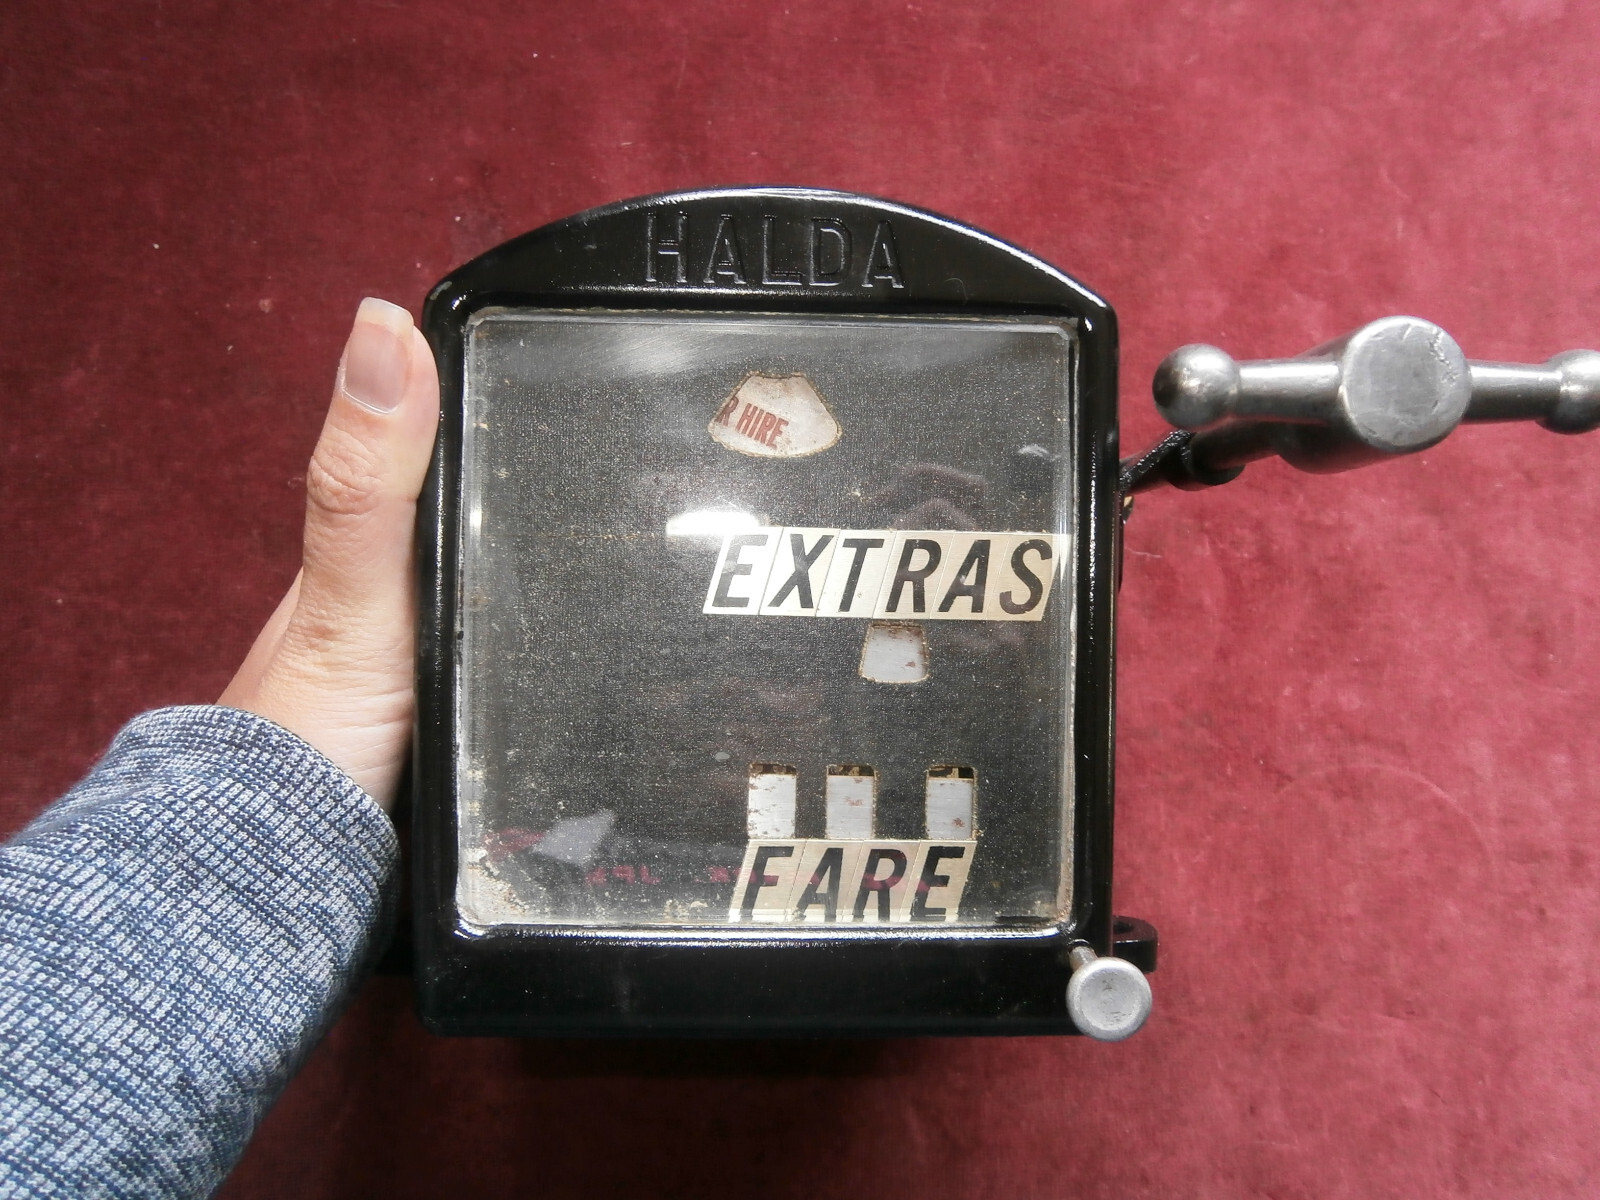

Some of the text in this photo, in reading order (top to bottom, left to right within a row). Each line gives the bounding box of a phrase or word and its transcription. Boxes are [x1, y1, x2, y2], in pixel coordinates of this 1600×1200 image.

[646, 211, 904, 288] HALDA
[735, 402, 790, 450] HIRE
[711, 533, 1053, 615] EXTRAS
[738, 845, 966, 923] FARE
